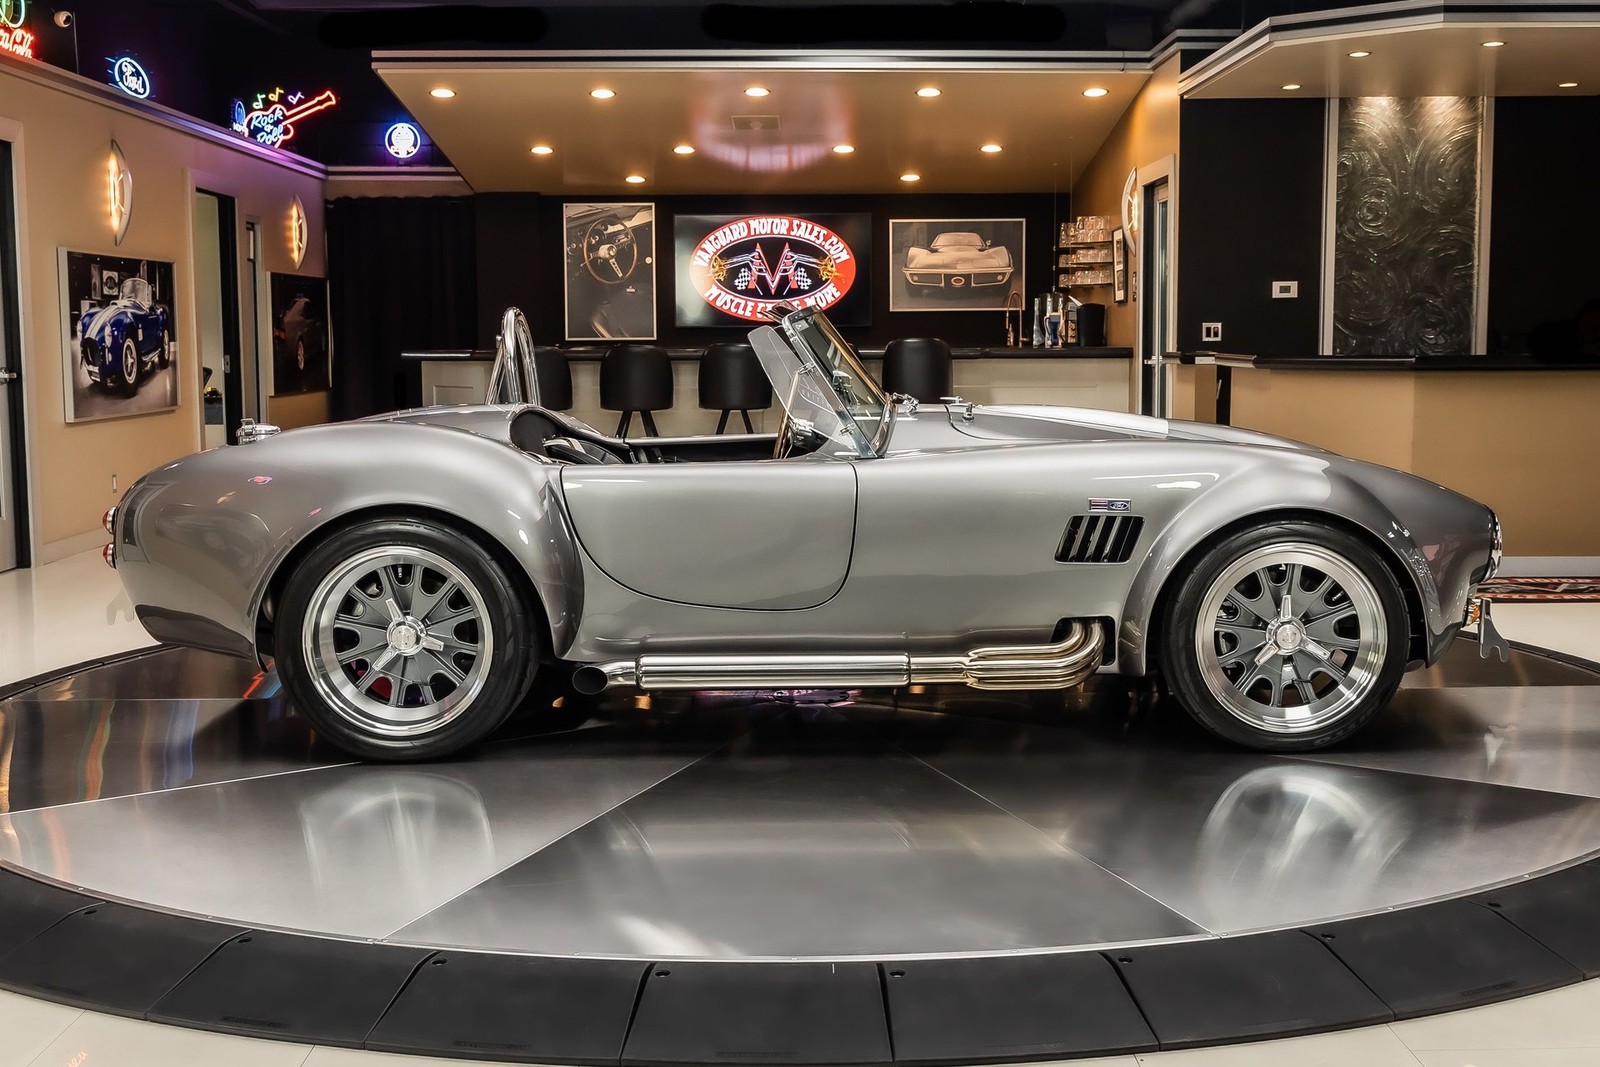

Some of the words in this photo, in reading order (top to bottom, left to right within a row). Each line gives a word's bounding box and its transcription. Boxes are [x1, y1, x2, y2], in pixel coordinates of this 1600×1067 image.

[250, 107, 284, 130] Rock
[693, 221, 748, 267] VANGUARD
[748, 218, 789, 236] MOTOR
[790, 219, 851, 264] SALES.COM
[703, 284, 755, 317] MUSCLE
[803, 283, 842, 309] MORE
